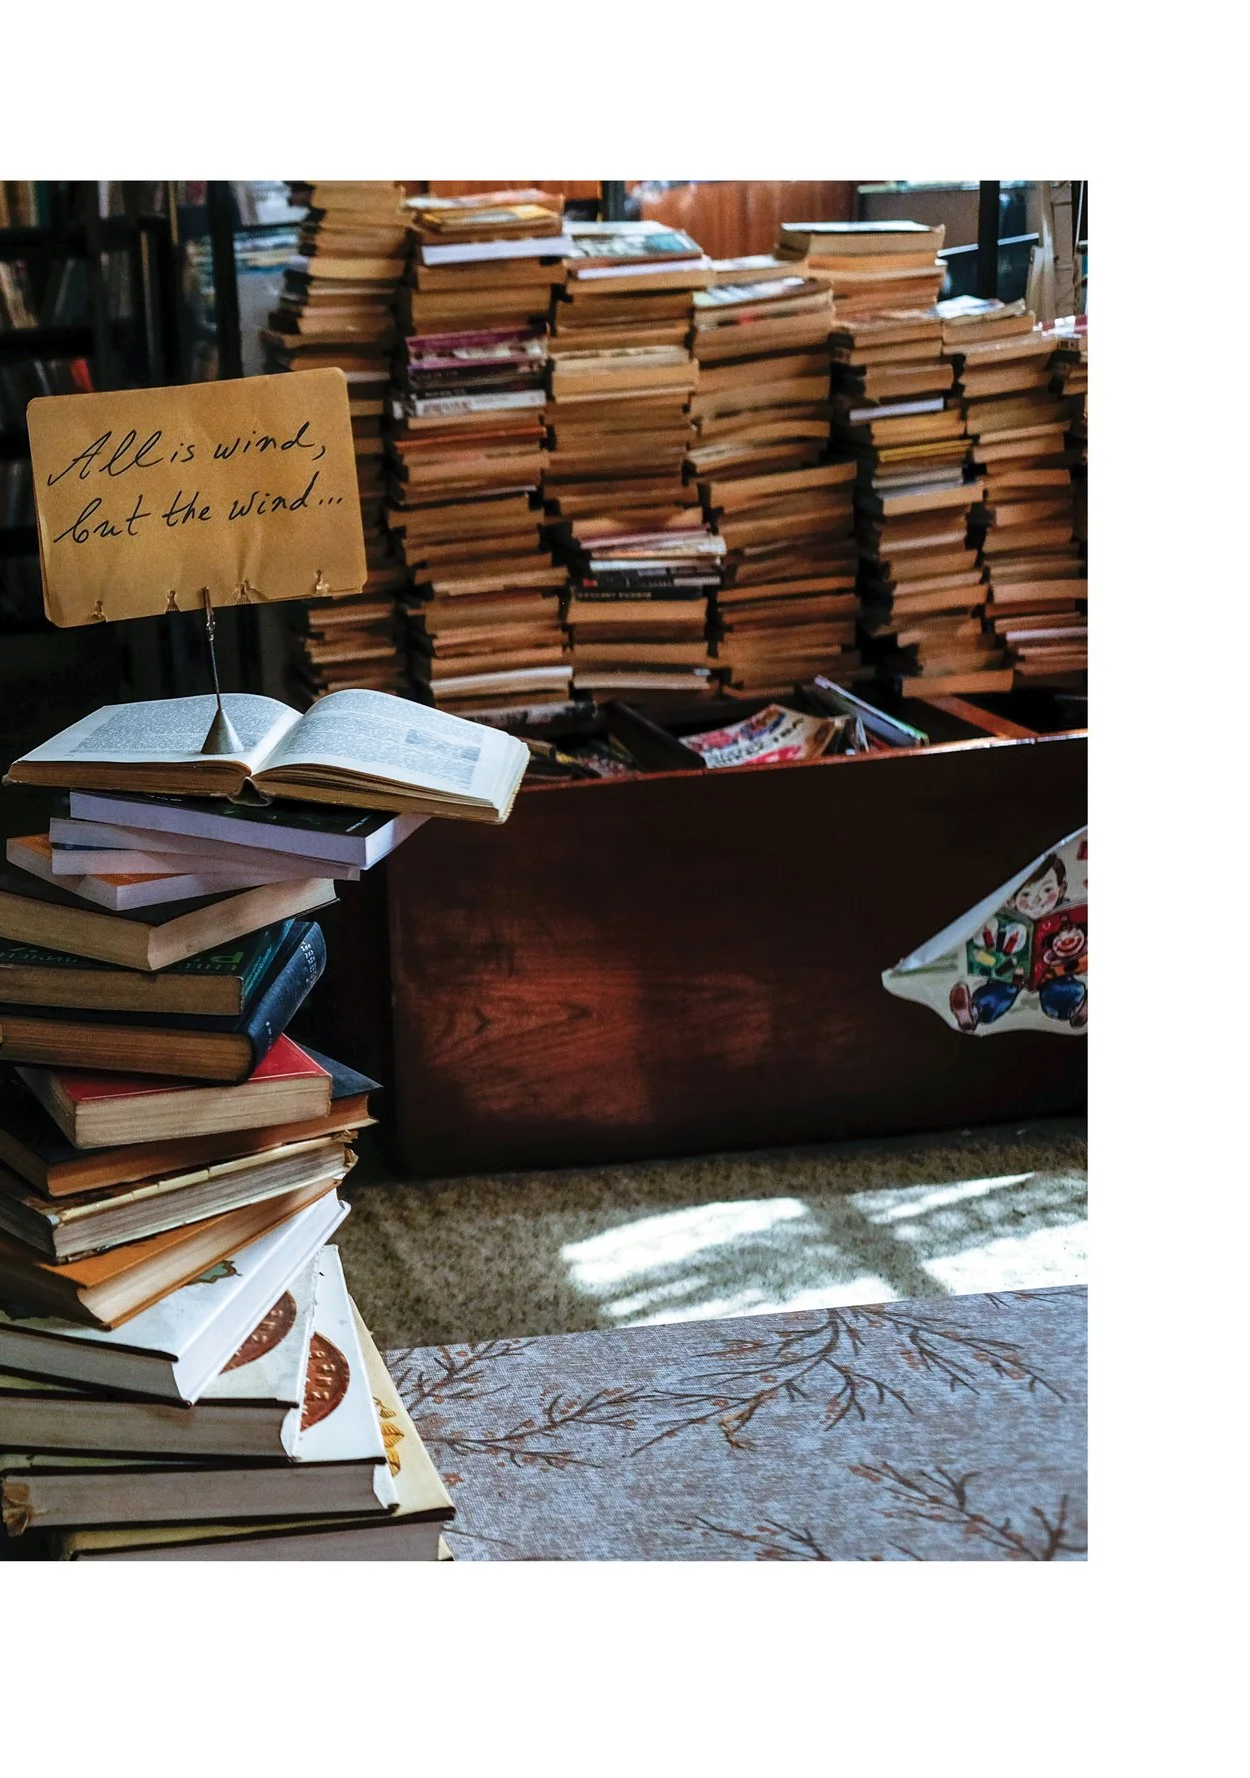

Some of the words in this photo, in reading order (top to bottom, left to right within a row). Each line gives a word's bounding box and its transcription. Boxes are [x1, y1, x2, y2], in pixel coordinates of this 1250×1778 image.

[47, 429, 164, 487] All
[170, 442, 195, 463] is
[214, 421, 326, 461] wind,
[53, 494, 151, 544] but
[162, 490, 211, 526] the
[229, 471, 344, 521] wind...
